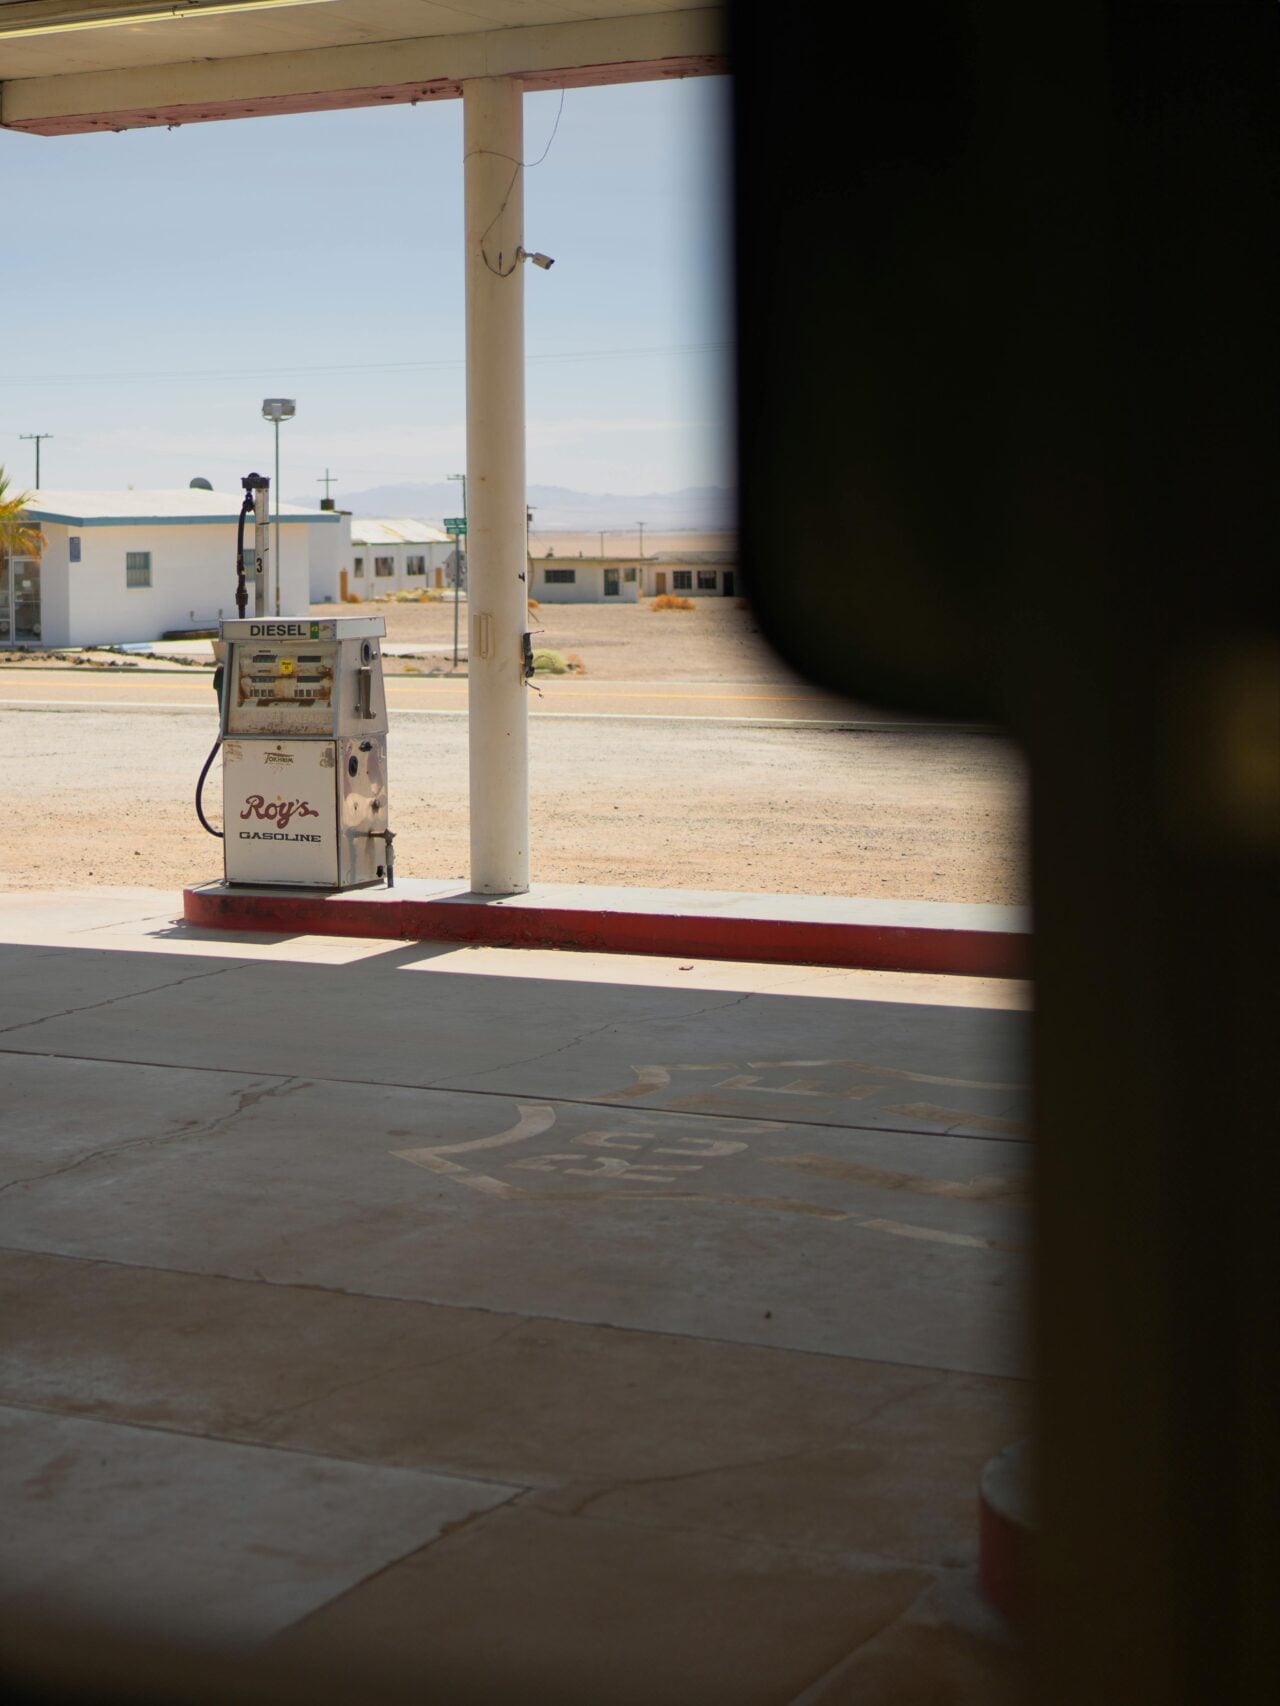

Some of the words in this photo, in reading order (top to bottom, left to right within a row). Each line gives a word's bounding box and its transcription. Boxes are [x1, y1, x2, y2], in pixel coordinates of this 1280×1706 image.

[250, 624, 307, 637] DIESEL
[240, 794, 320, 829] Roy's
[239, 831, 322, 843] GASOLINE
